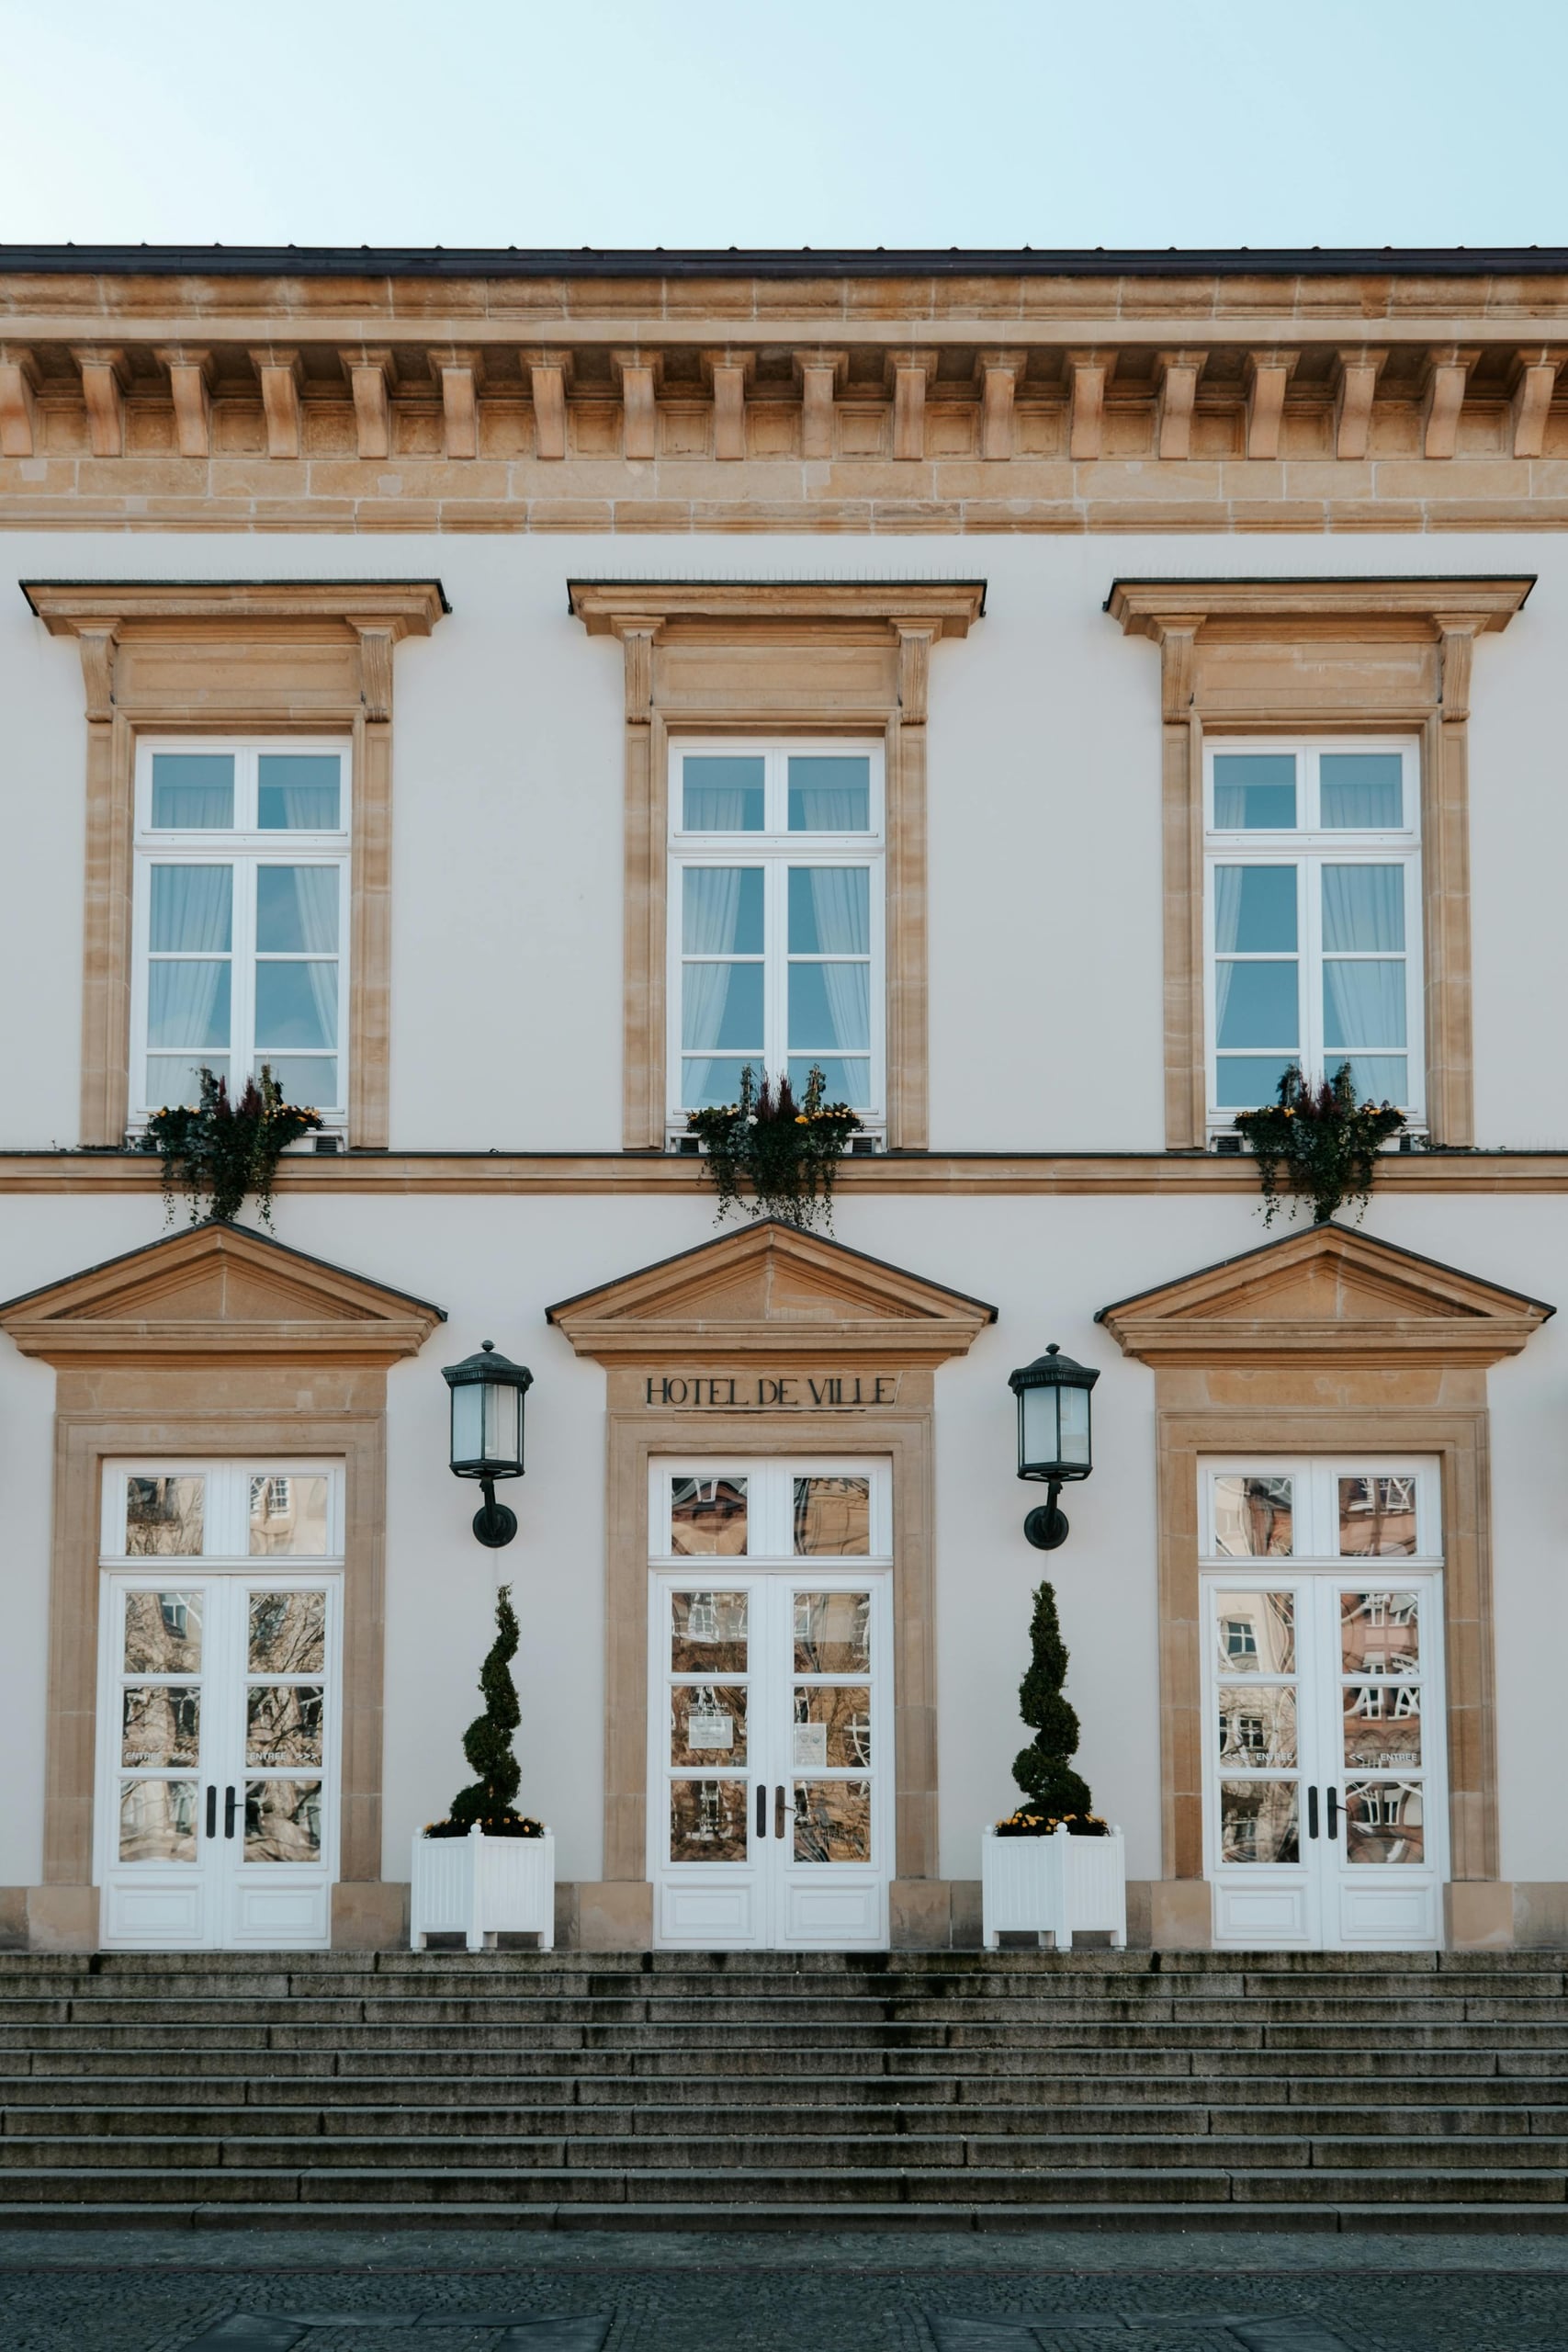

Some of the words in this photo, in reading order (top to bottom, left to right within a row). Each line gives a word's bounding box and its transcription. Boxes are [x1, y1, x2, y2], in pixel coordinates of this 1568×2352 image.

[646, 1377, 750, 1405] HOTEL
[758, 1377, 798, 1405] DE
[807, 1377, 896, 1405] VILLE
